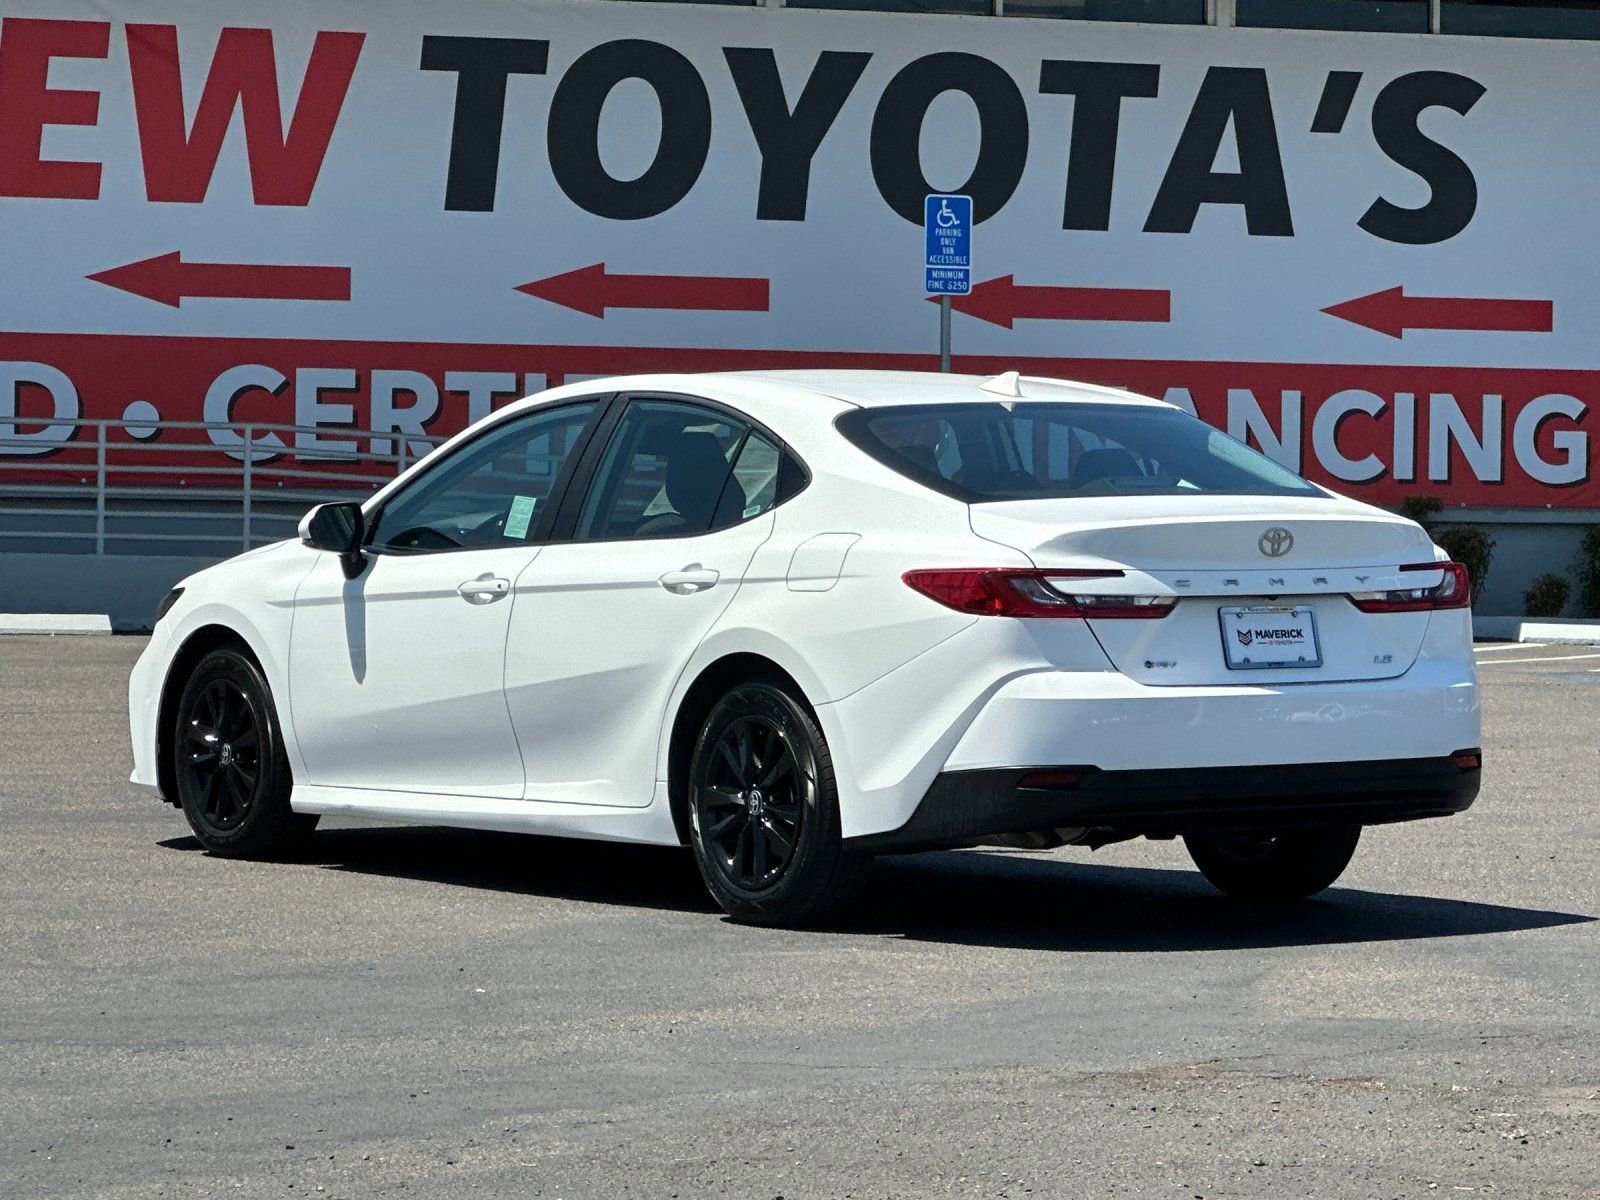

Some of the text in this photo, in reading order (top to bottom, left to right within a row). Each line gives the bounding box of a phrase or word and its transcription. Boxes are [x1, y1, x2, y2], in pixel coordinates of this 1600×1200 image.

[420, 35, 1487, 244] TOYOTA'S
[935, 228, 962, 237] PARKING
[940, 237, 956, 246] ONLY
[942, 246, 955, 255] VAN
[929, 255, 967, 264] ACCESSIBLE
[931, 269, 964, 279] MINIMUM
[927, 280, 967, 290] FINE $250
[1255, 629, 1304, 639] MAVERICK
